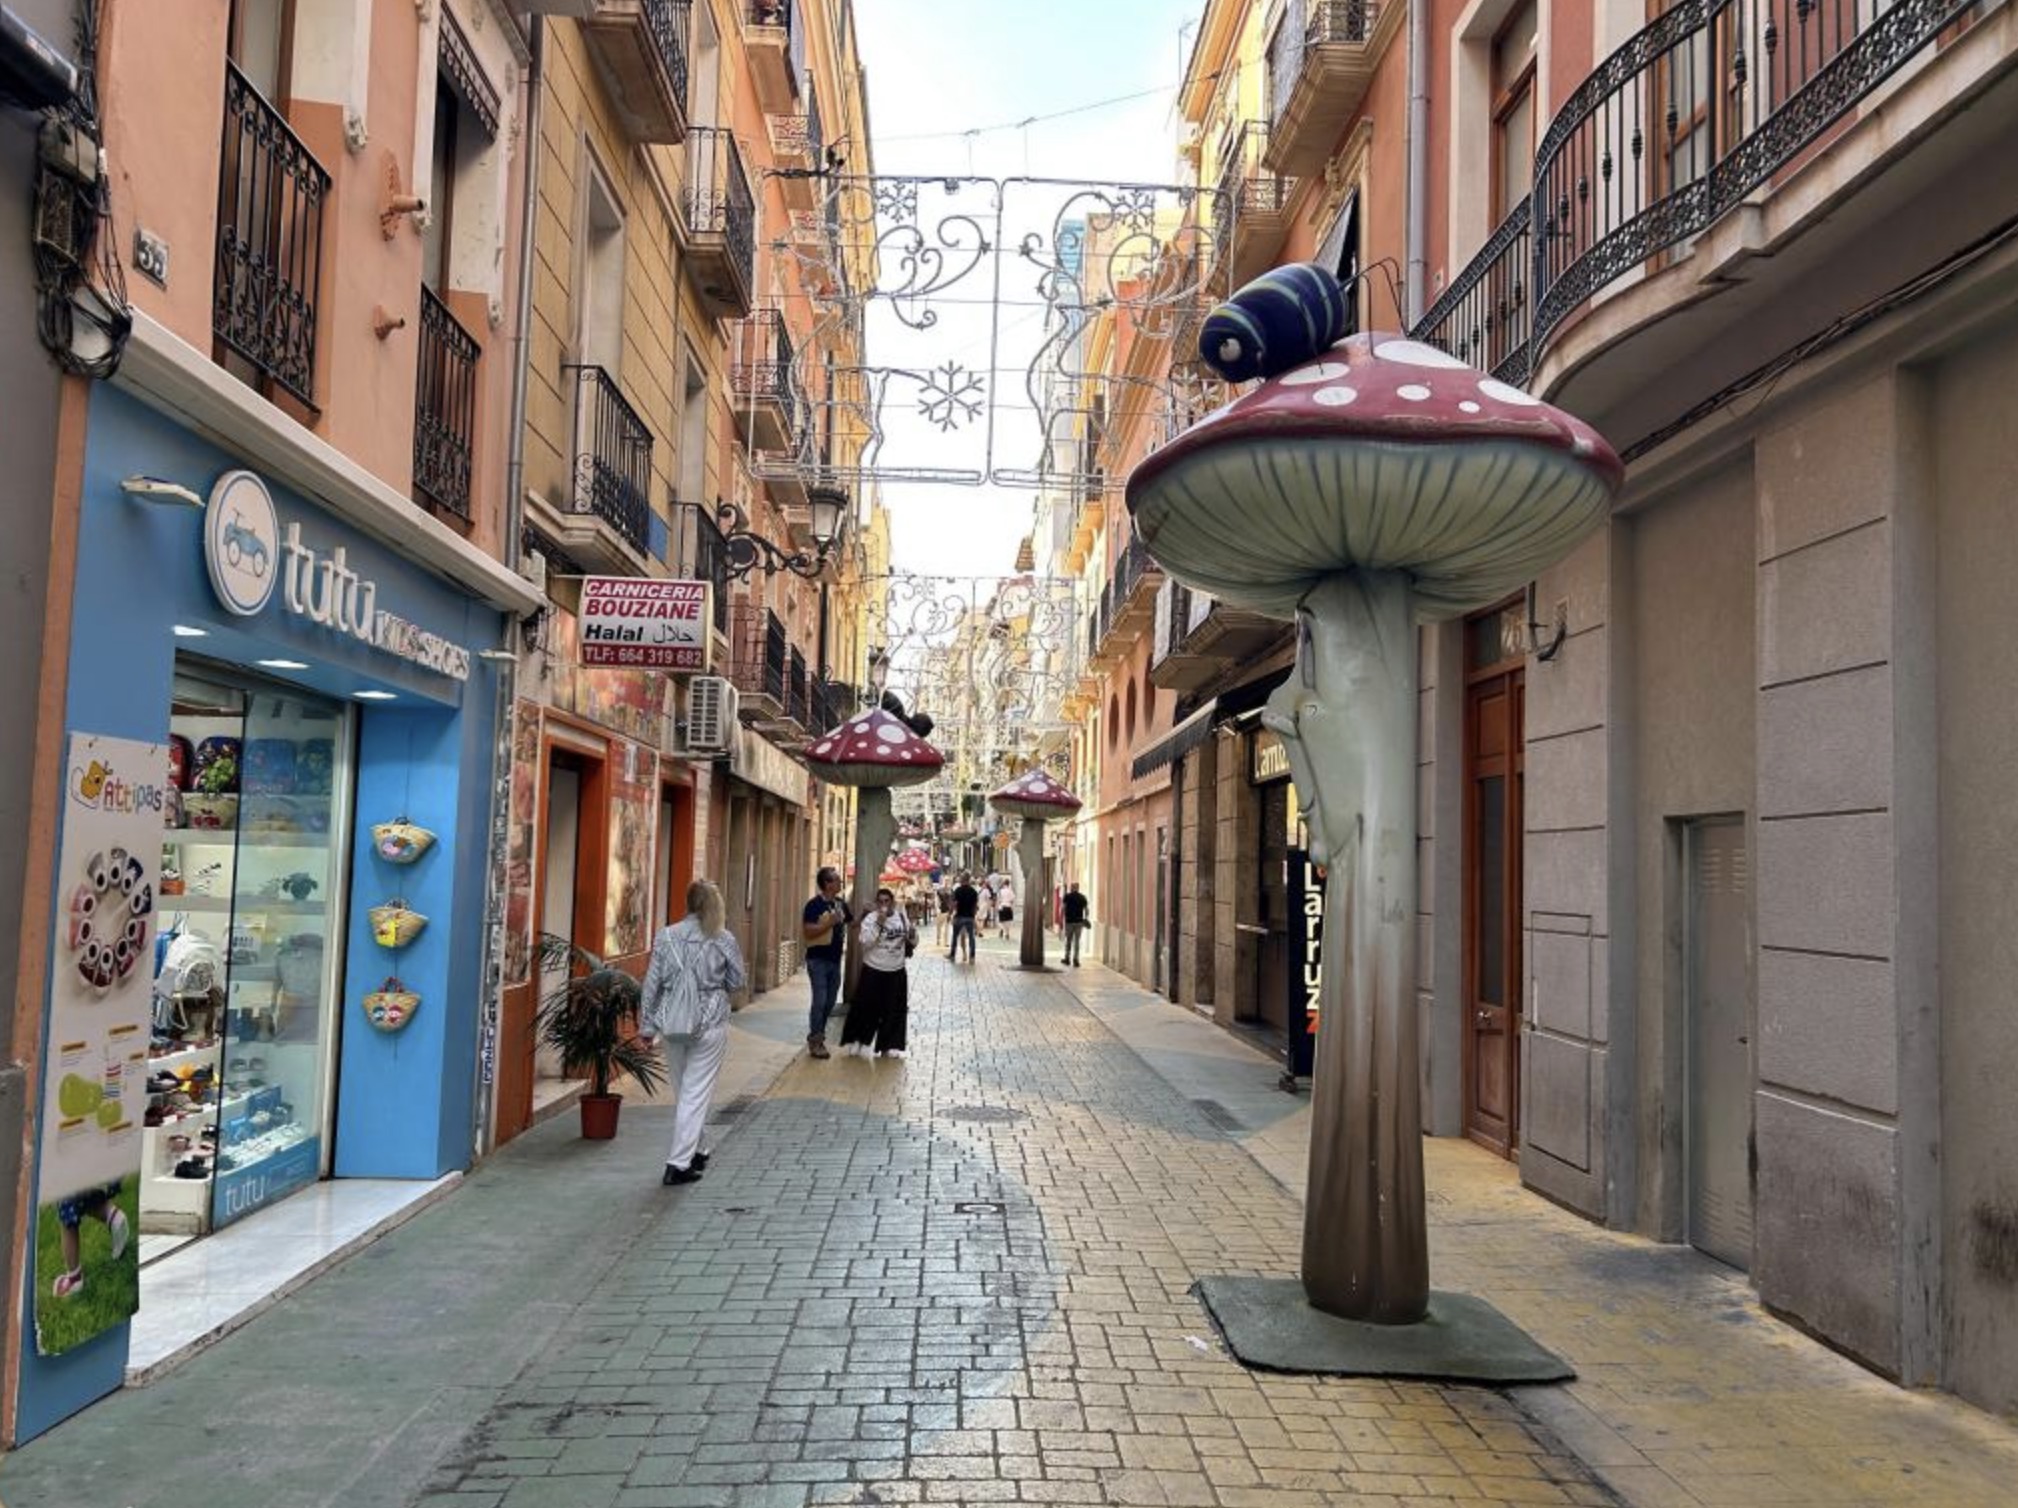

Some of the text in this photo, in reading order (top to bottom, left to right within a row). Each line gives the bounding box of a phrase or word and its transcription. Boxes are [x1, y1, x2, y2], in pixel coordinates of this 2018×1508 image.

[282, 522, 375, 645] tutu
[586, 582, 704, 600] CARNICERIA
[585, 599, 700, 620] BOUZIANE
[585, 624, 643, 641] Halal
[653, 623, 694, 643] حلال
[584, 647, 701, 665] TLF: 664 319 682
[104, 778, 162, 816] Attipas
[226, 1174, 265, 1217] tutu
